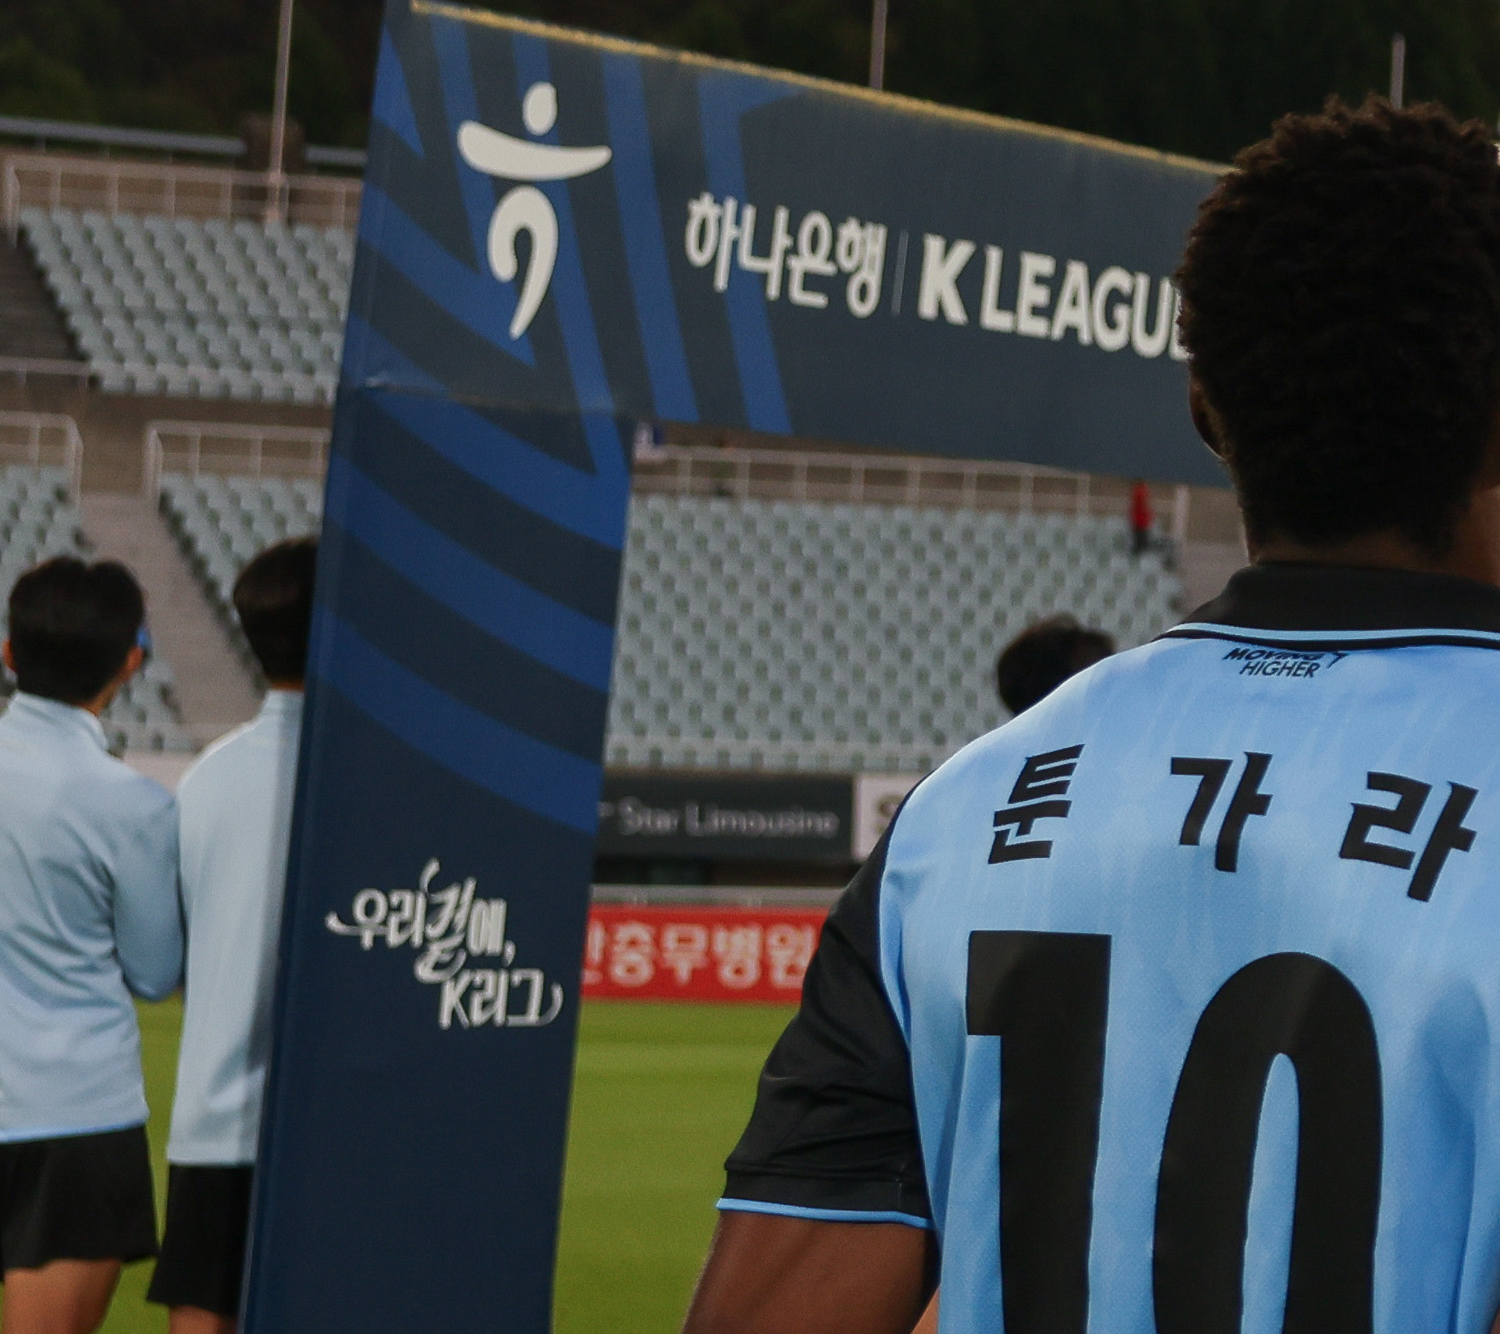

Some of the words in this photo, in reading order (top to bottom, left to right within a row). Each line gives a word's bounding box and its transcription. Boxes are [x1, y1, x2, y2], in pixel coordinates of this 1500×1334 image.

[684, 190, 887, 320] 하나은행
[917, 232, 979, 328] K
[1222, 647, 1327, 661] MOVING
[1238, 660, 1321, 678] HIGHER
[437, 967, 564, 1031] K리그
